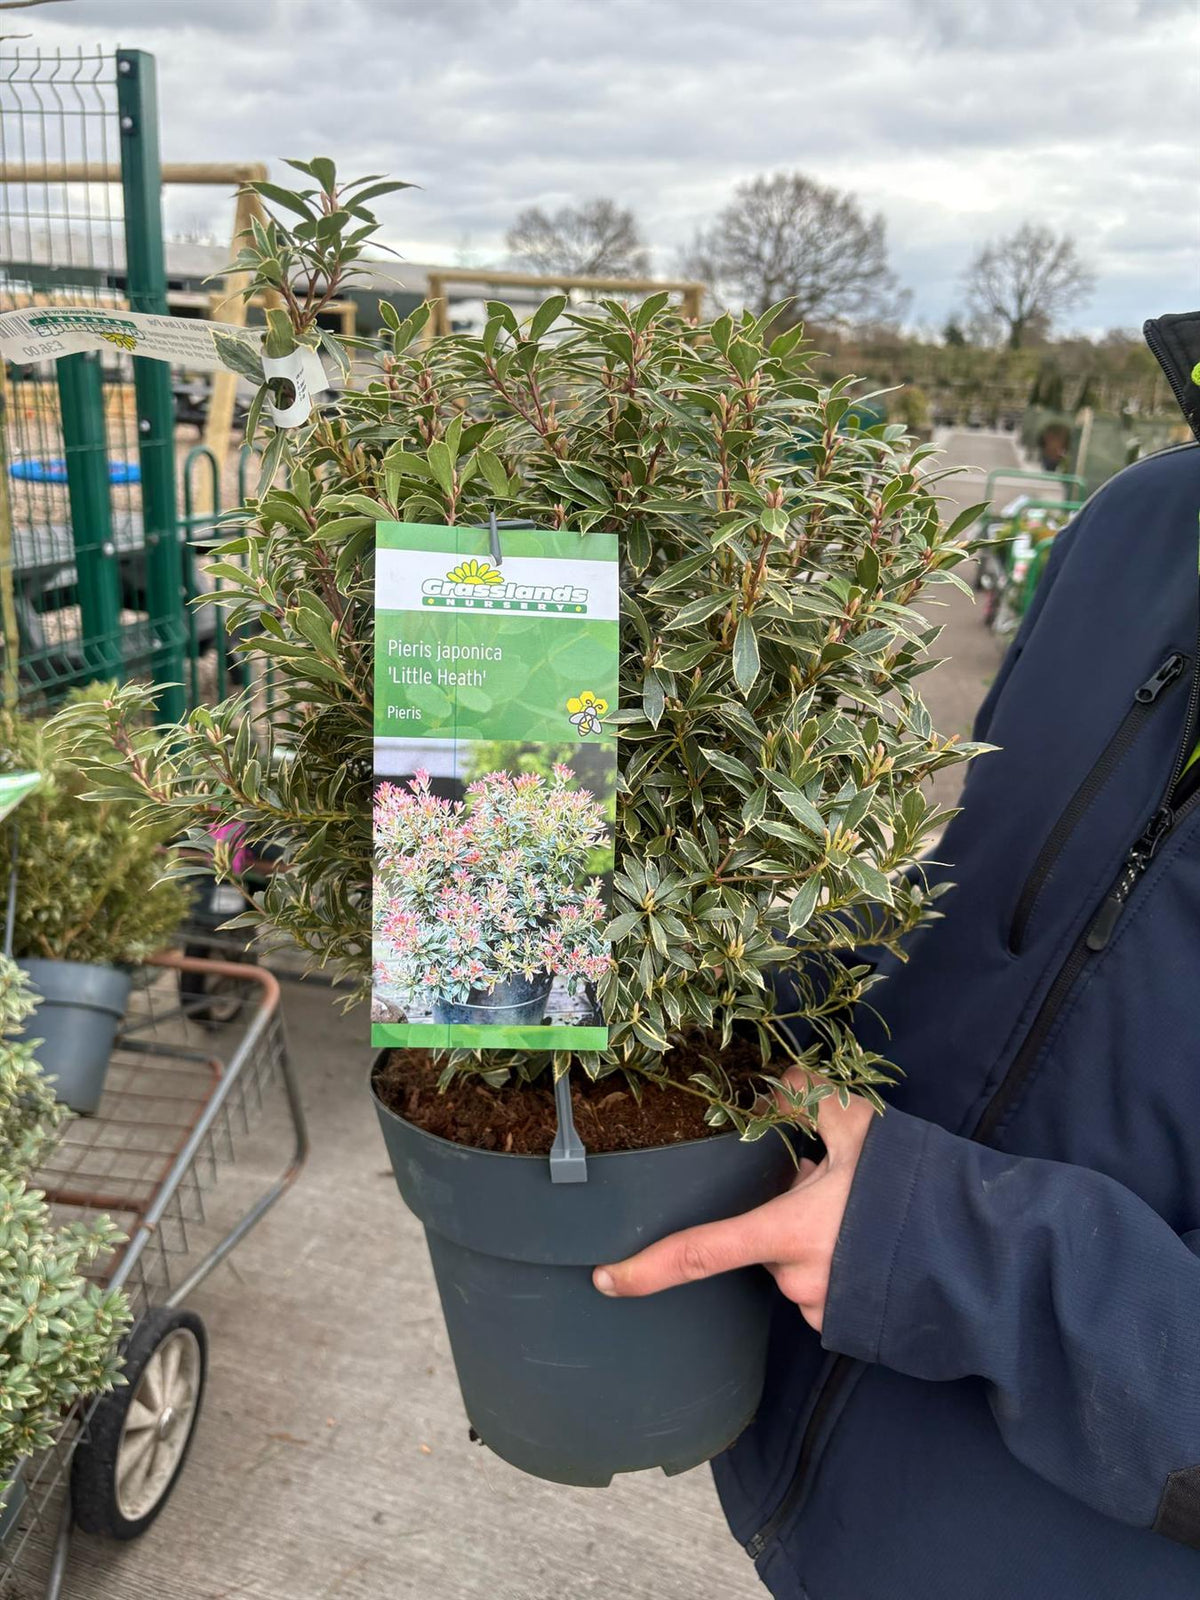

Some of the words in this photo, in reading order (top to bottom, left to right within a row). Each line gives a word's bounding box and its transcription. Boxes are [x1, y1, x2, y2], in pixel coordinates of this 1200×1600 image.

[421, 578, 589, 603] Grasslands
[446, 598, 566, 612] NURSERY
[388, 639, 432, 658] Pieris
[436, 641, 503, 662] japonica
[388, 666, 433, 685] 'Little
[437, 668, 486, 686] Heath'
[387, 705, 422, 719] Pieris
